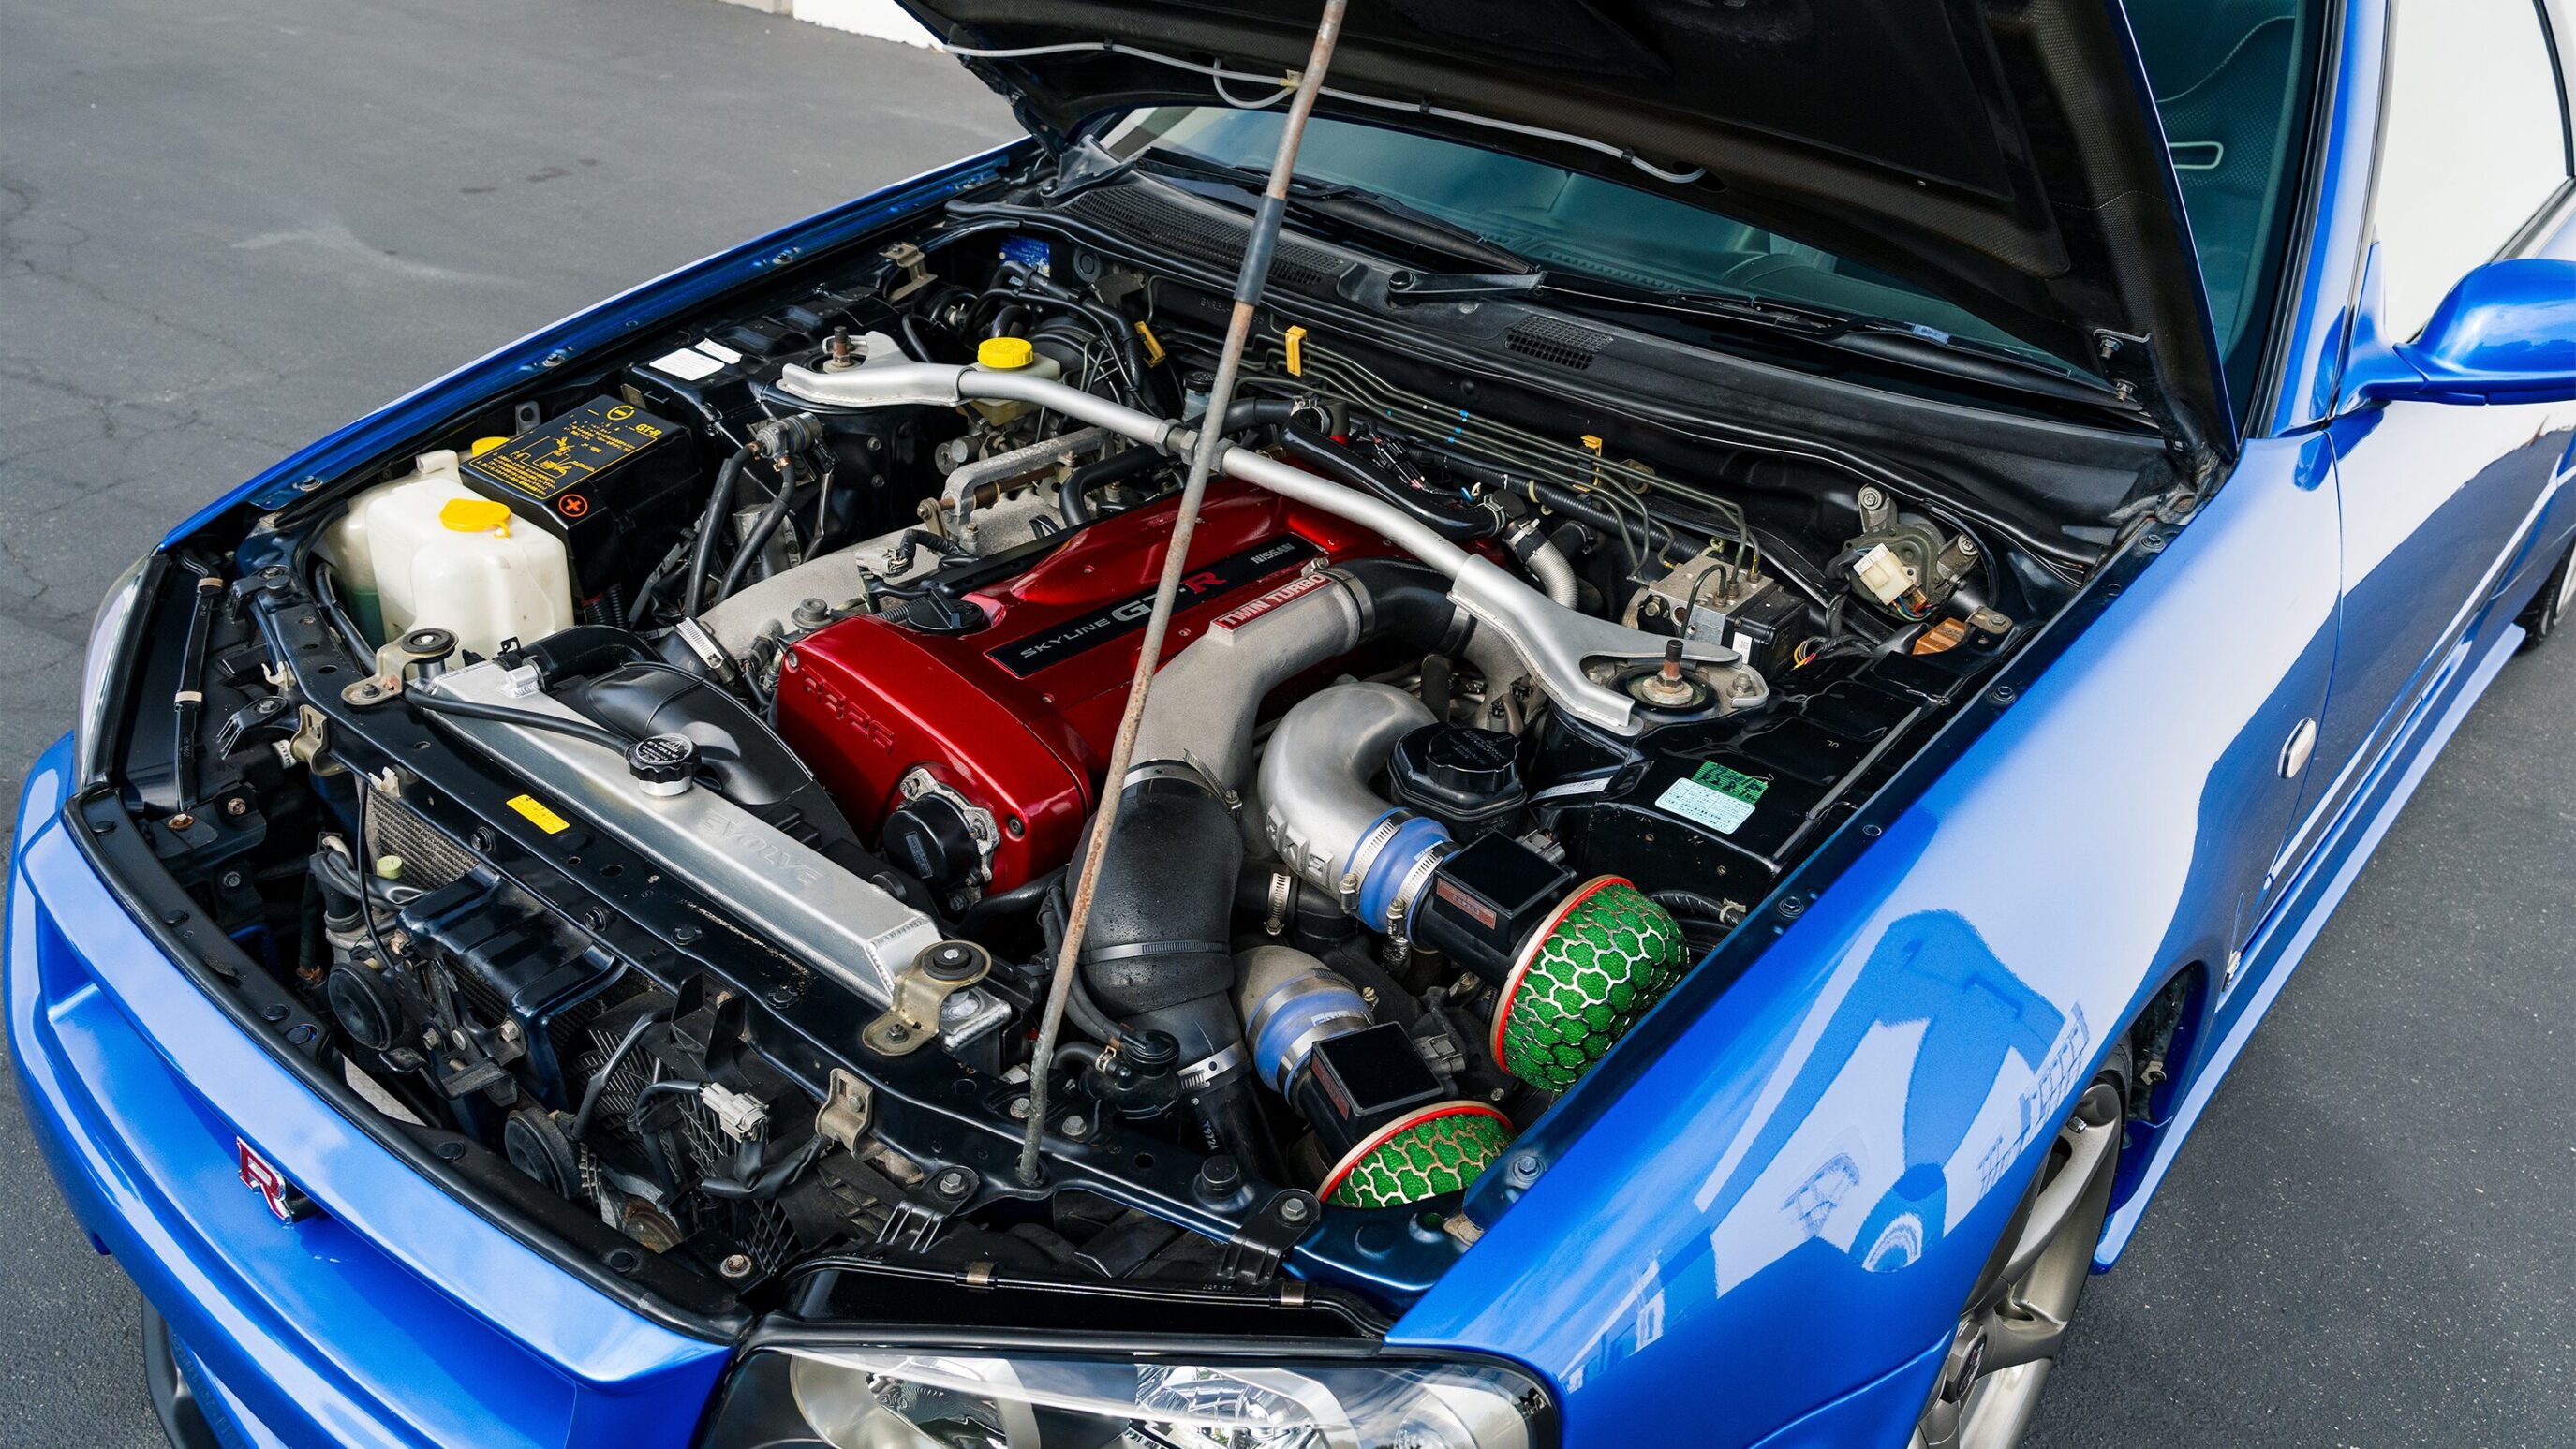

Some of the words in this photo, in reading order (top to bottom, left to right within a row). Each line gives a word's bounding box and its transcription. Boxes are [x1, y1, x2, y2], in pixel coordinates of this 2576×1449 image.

[635, 423, 662, 437] GT-R
[1250, 542, 1295, 564] NISSAN
[1020, 618, 1111, 658] SKYLINE
[1111, 571, 1228, 621] G-R
[1219, 600, 1271, 626] TWIN
[1265, 574, 1326, 603] TURBO
[801, 664, 895, 755] RB26
[703, 809, 824, 885] EVOLVE
[236, 1135, 291, 1223] R
